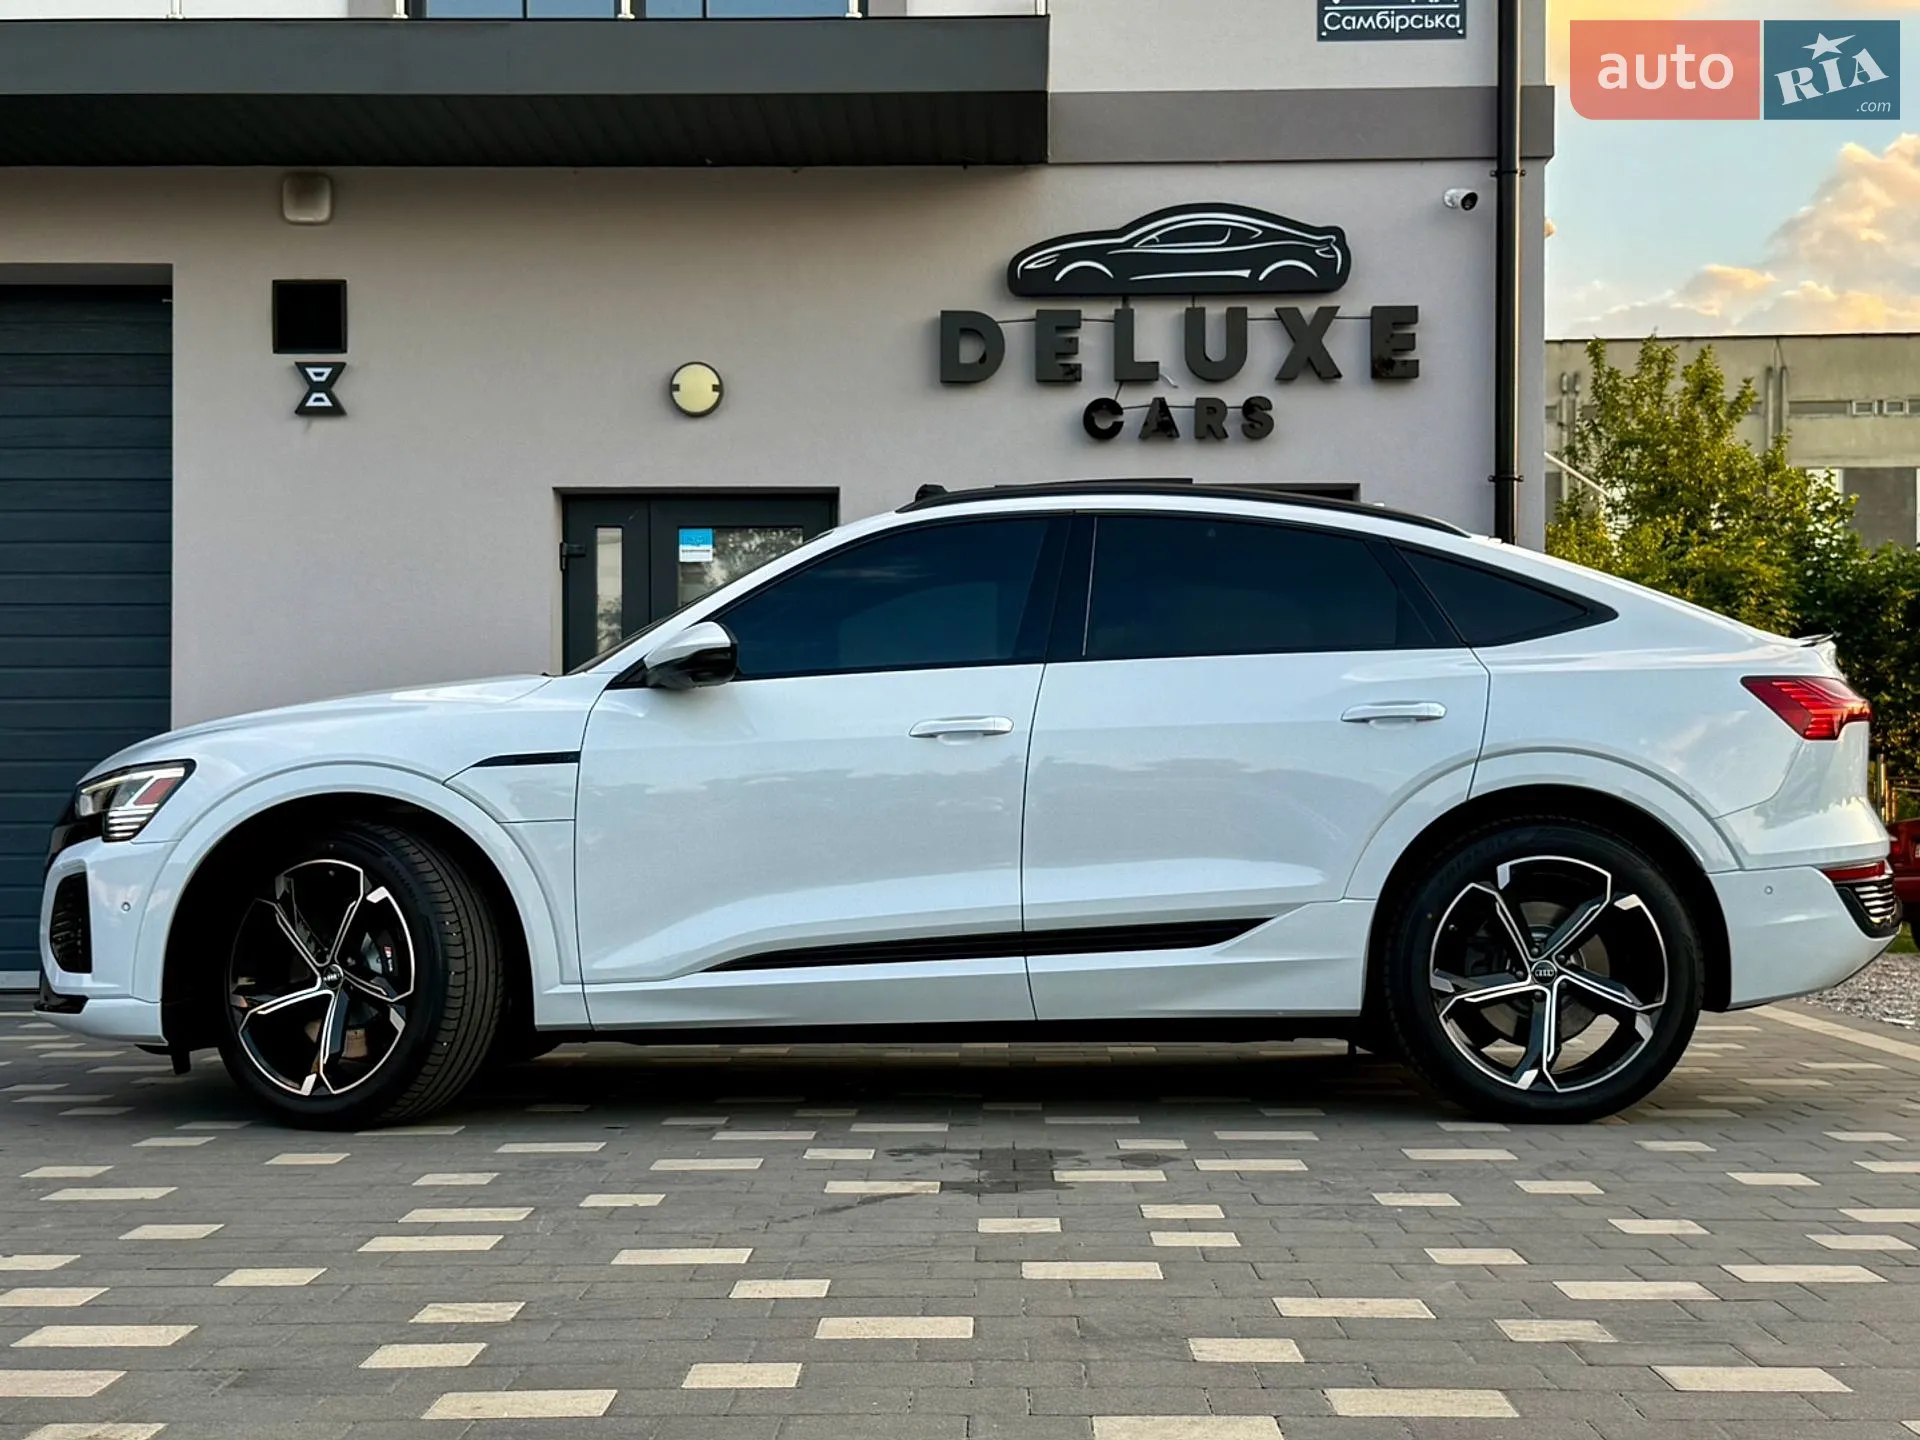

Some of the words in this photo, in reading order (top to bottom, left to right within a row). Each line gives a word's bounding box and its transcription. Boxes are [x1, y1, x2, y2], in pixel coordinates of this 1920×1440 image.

[1323, 10, 1460, 33] Самбірська
[940, 305, 1419, 383] DELUXE
[1083, 396, 1275, 440] CARS
